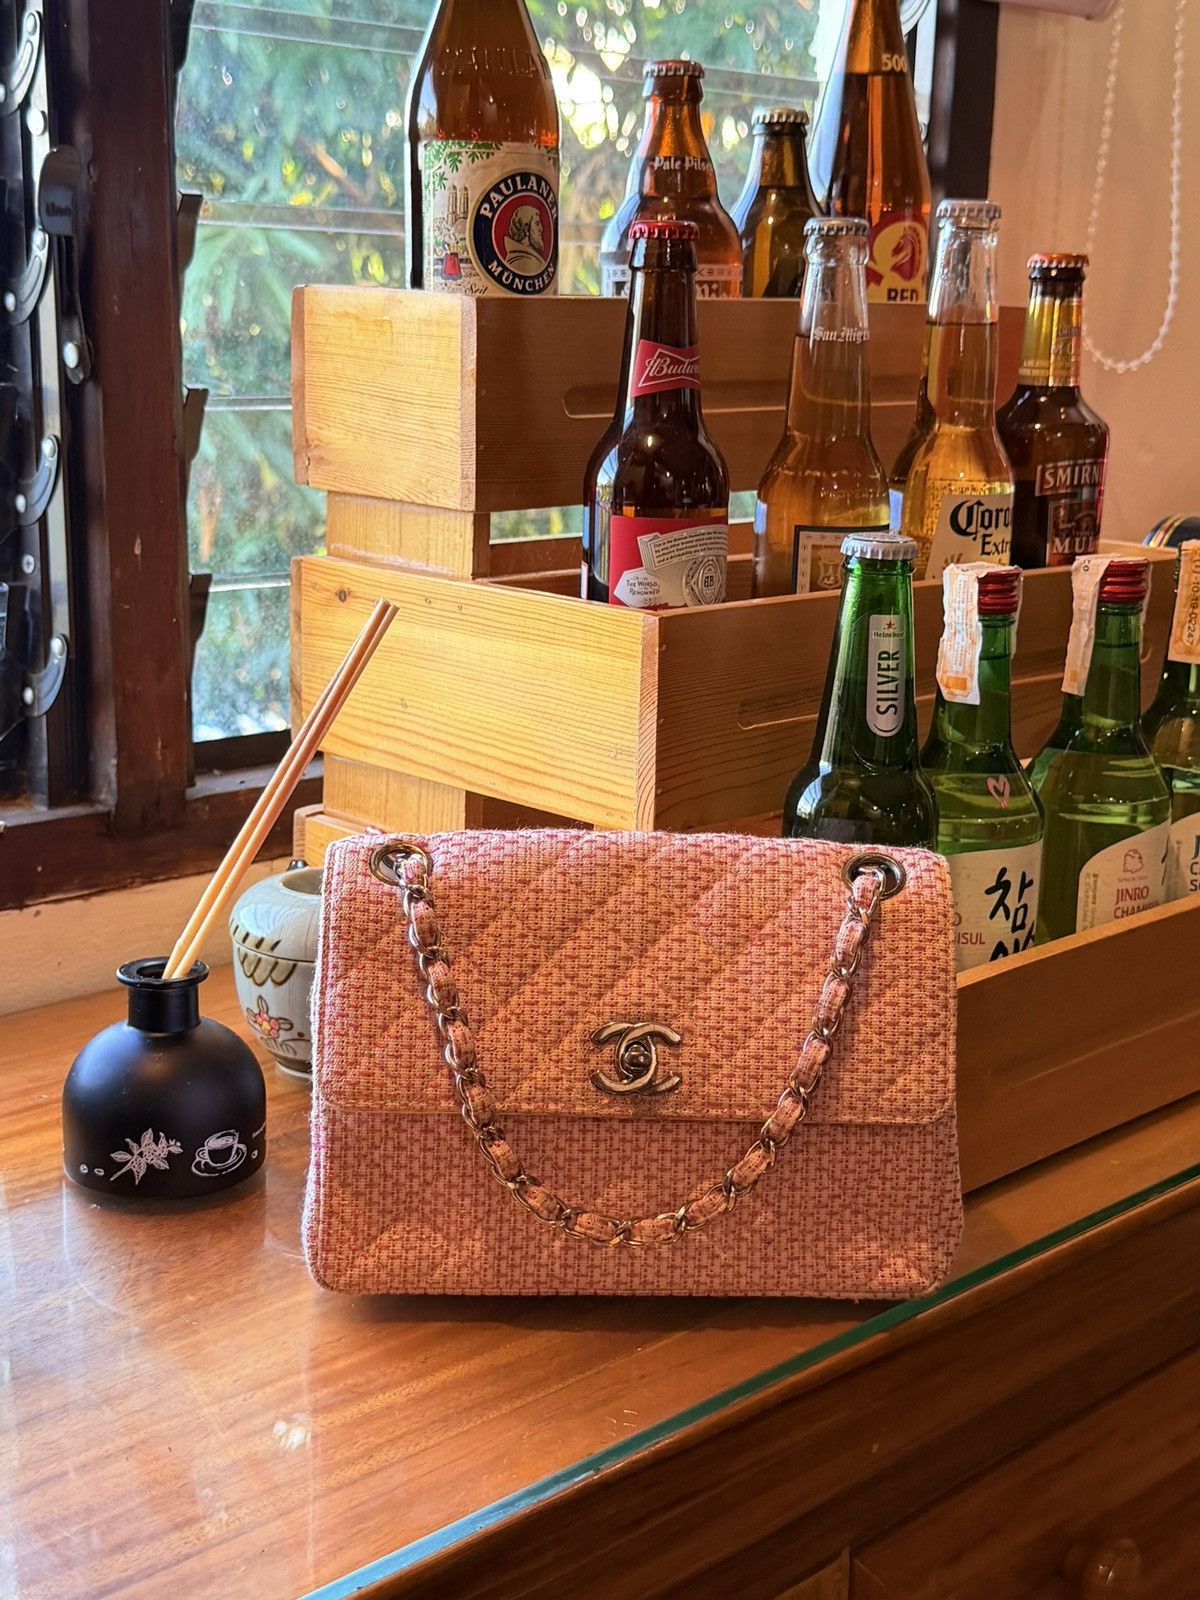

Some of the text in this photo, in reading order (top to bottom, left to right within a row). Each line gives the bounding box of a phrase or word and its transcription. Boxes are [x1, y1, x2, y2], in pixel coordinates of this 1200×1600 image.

[881, 54, 907, 73] 500
[655, 155, 681, 171] Pale
[488, 260, 555, 292] MÜNCHEN
[814, 326, 837, 341] San
[875, 649, 900, 716] SILVER
[984, 866, 1034, 934] 참
[1115, 885, 1149, 906] JINRO
